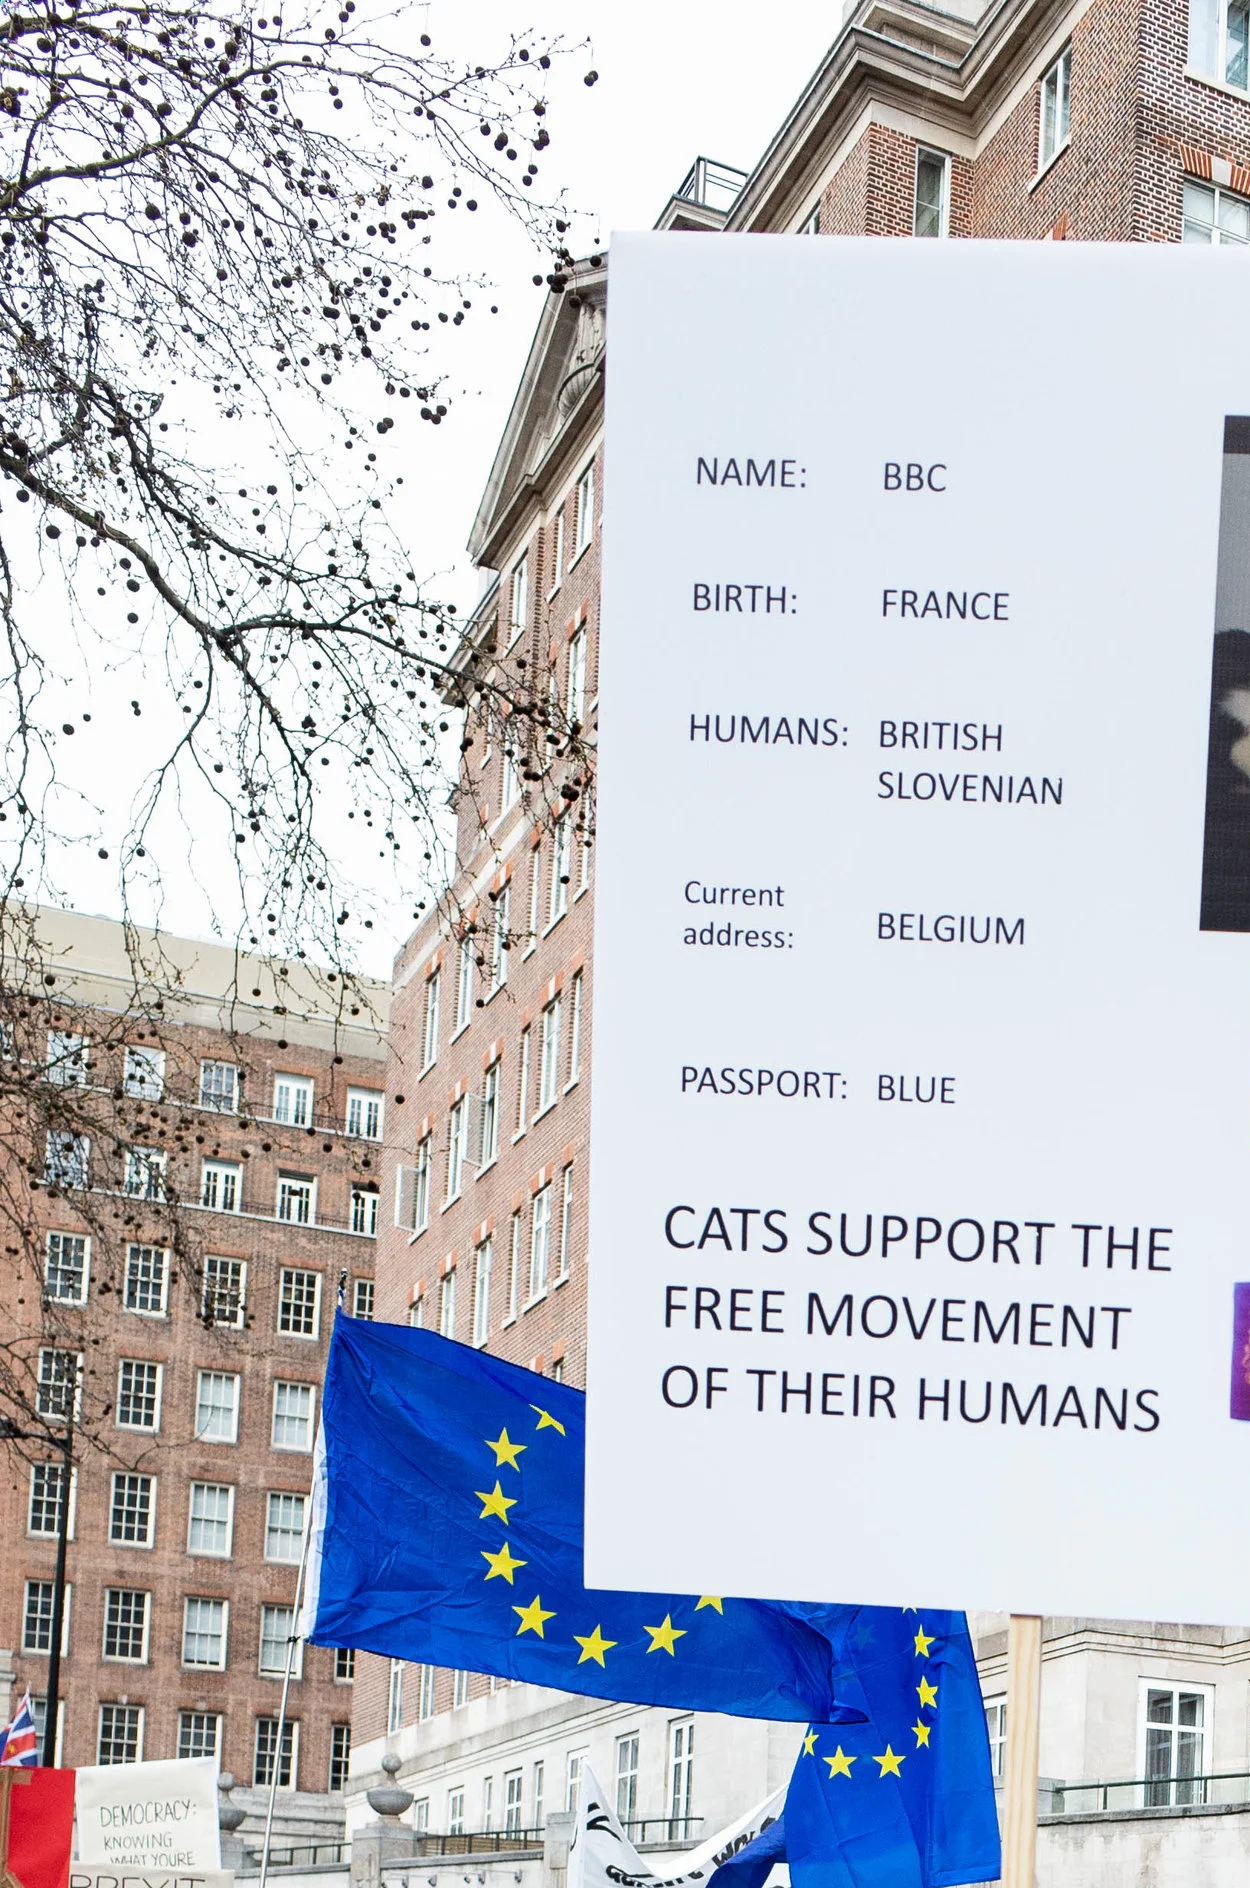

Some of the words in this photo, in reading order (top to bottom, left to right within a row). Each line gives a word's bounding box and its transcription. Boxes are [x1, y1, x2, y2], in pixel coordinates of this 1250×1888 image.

[696, 456, 806, 488] NAME:
[884, 462, 947, 492] BBC
[693, 583, 797, 614] BIRTH:
[882, 589, 1010, 621] FRANCE
[690, 713, 848, 747] HUMANS:
[879, 720, 1002, 752] BRITISH
[877, 771, 1063, 805] SLOVENIAN
[684, 880, 785, 907] Current
[683, 921, 793, 949] address:
[878, 912, 1025, 945] BELGIUM
[681, 1066, 847, 1100] PASSPORT:
[878, 1074, 956, 1104] BLUE
[664, 1205, 788, 1254] CATS
[806, 1211, 1056, 1266] SUPPORT
[1071, 1223, 1173, 1272] THE
[665, 1285, 785, 1334] FREE
[807, 1292, 1132, 1350] MOVEMENT
[661, 1365, 729, 1410] OF
[745, 1368, 897, 1419] THEIR
[918, 1377, 1160, 1433] HUMANS
[100, 1798, 197, 1828] DEMOCRACY:
[103, 1831, 172, 1851] KNOWING
